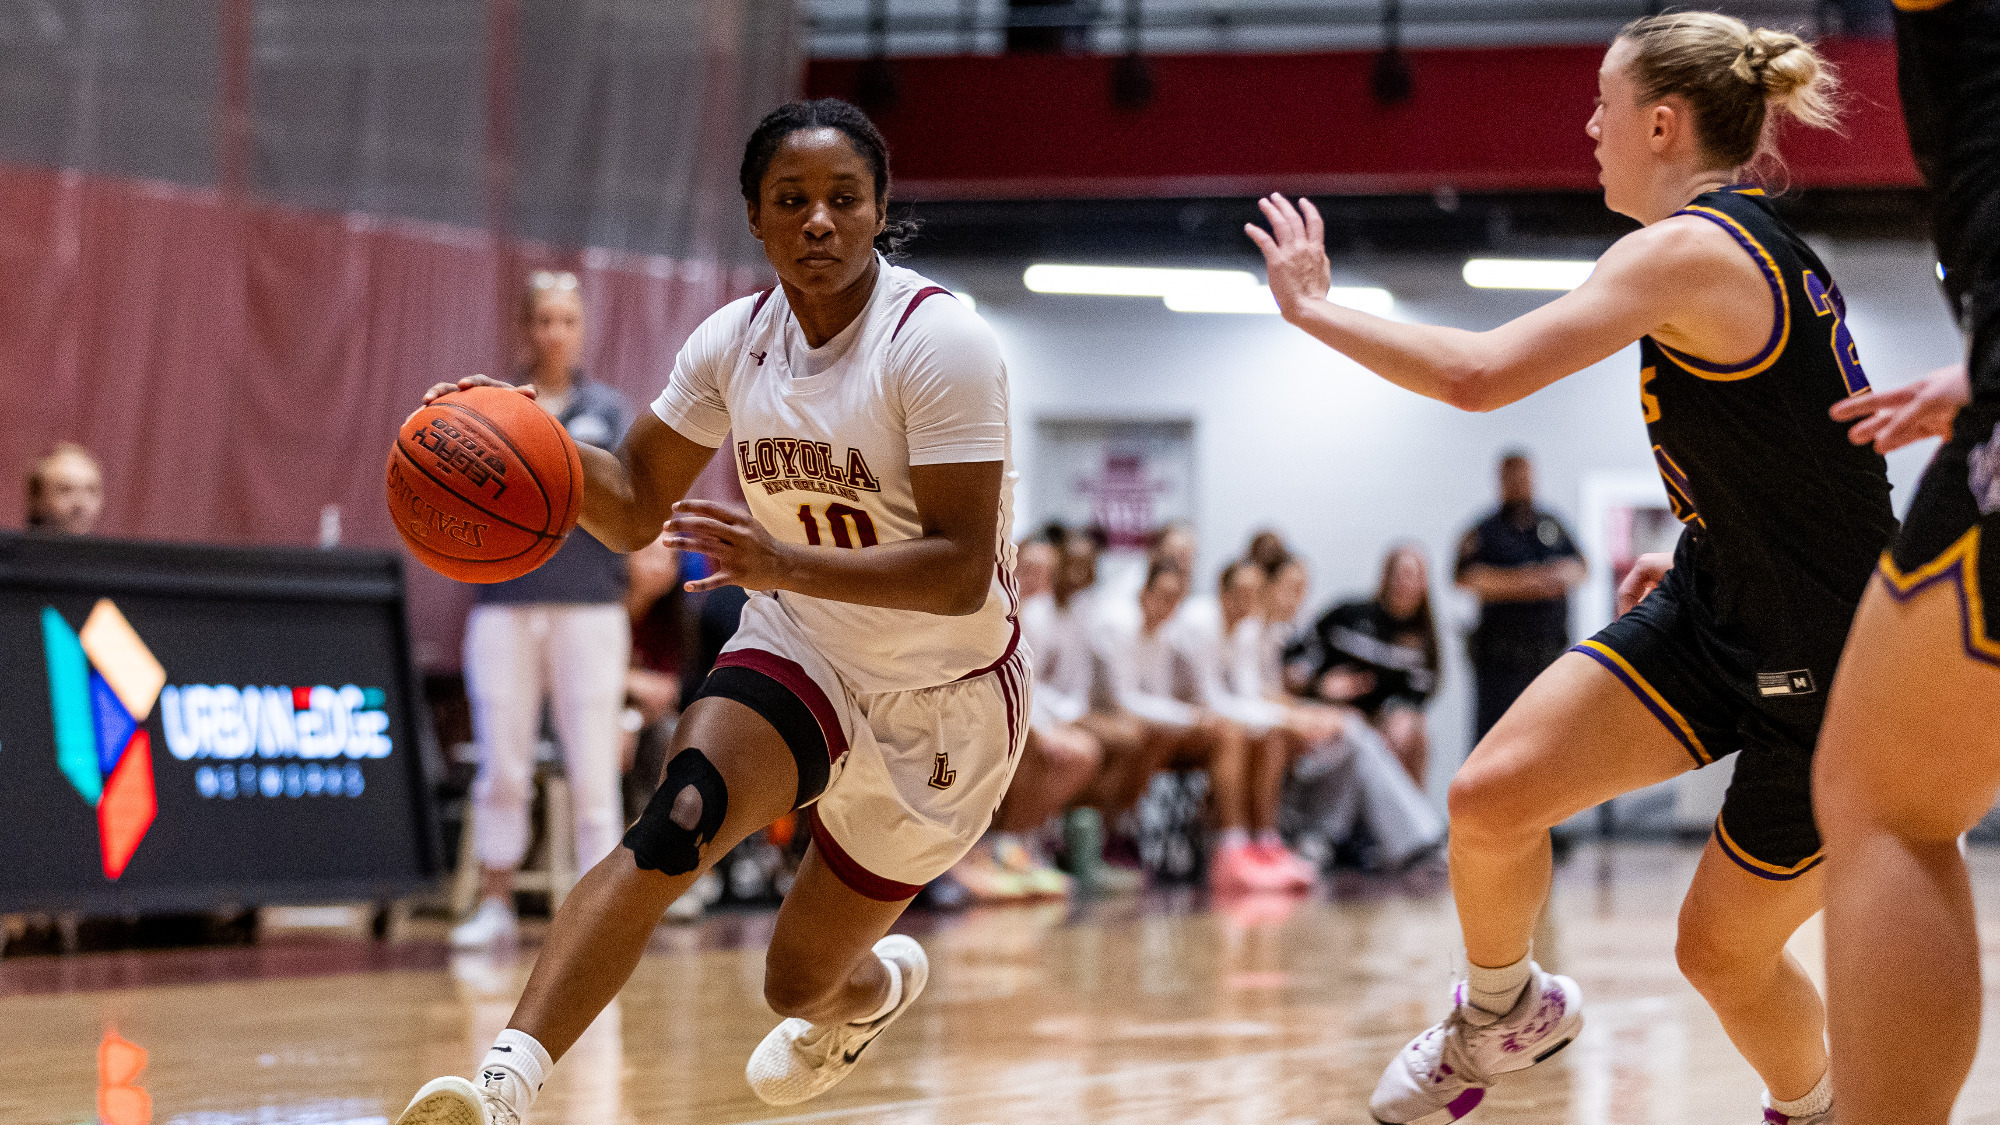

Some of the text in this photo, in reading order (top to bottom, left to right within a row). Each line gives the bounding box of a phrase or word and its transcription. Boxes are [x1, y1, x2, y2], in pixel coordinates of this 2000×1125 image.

[411, 426, 507, 500] LEGACY
[738, 438, 881, 492] LOYOLA
[761, 479, 860, 502] NEW ORLEANS
[797, 502, 879, 549] 10
[1793, 677, 1807, 689] M
[928, 752, 956, 790] L
